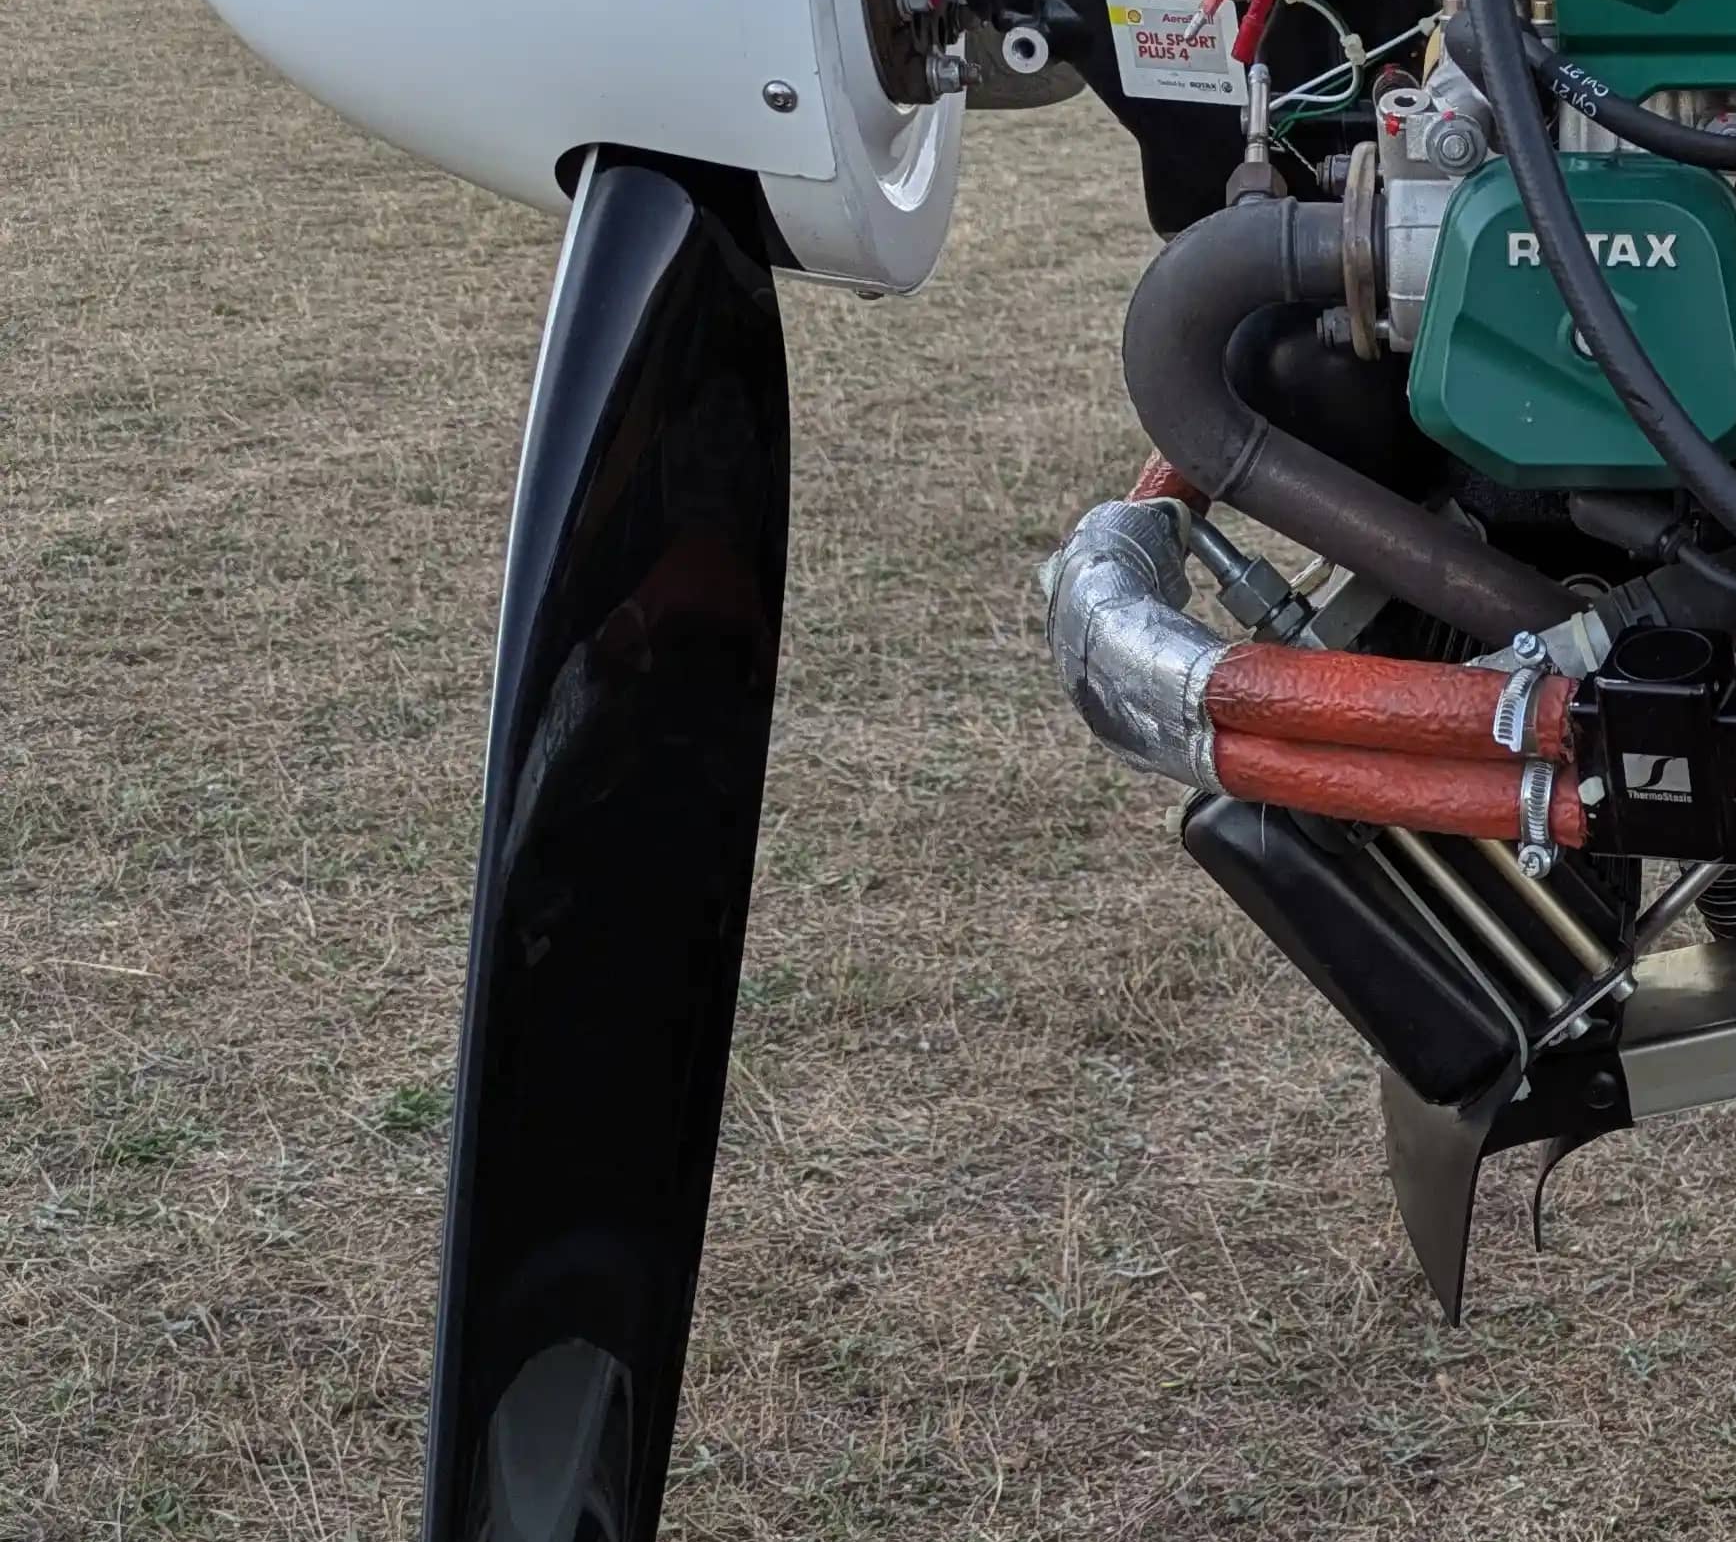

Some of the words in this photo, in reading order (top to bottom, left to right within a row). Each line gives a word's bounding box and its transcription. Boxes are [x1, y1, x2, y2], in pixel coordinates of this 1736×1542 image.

[1136, 31, 1163, 46] OIL
[1166, 33, 1217, 49] SPORT
[1138, 45, 1176, 60] PLUS
[1179, 48, 1190, 61] 4
[1508, 232, 1677, 267] RTAX
